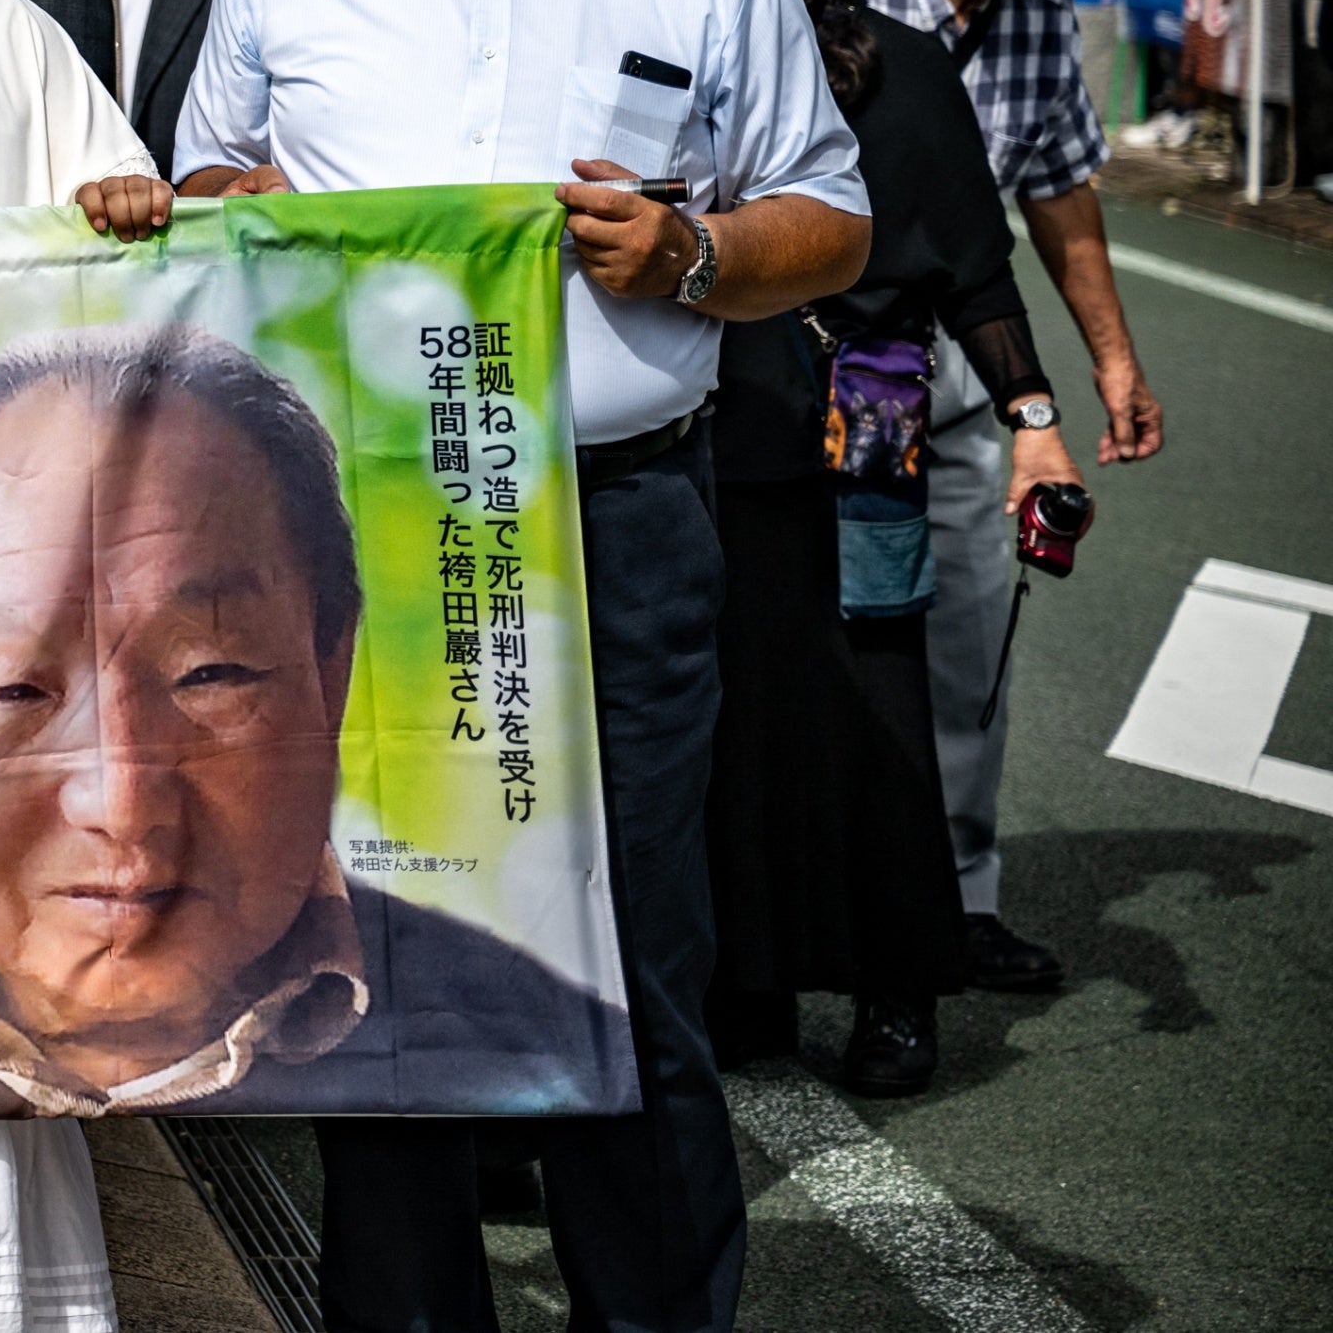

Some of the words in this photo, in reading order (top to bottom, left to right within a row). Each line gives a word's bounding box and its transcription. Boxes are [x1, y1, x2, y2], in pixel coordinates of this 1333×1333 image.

[473, 322, 537, 824] 証拠ねつ造で死刑判決を受け
[351, 857, 479, 872] 袴田さん支援クラブ
